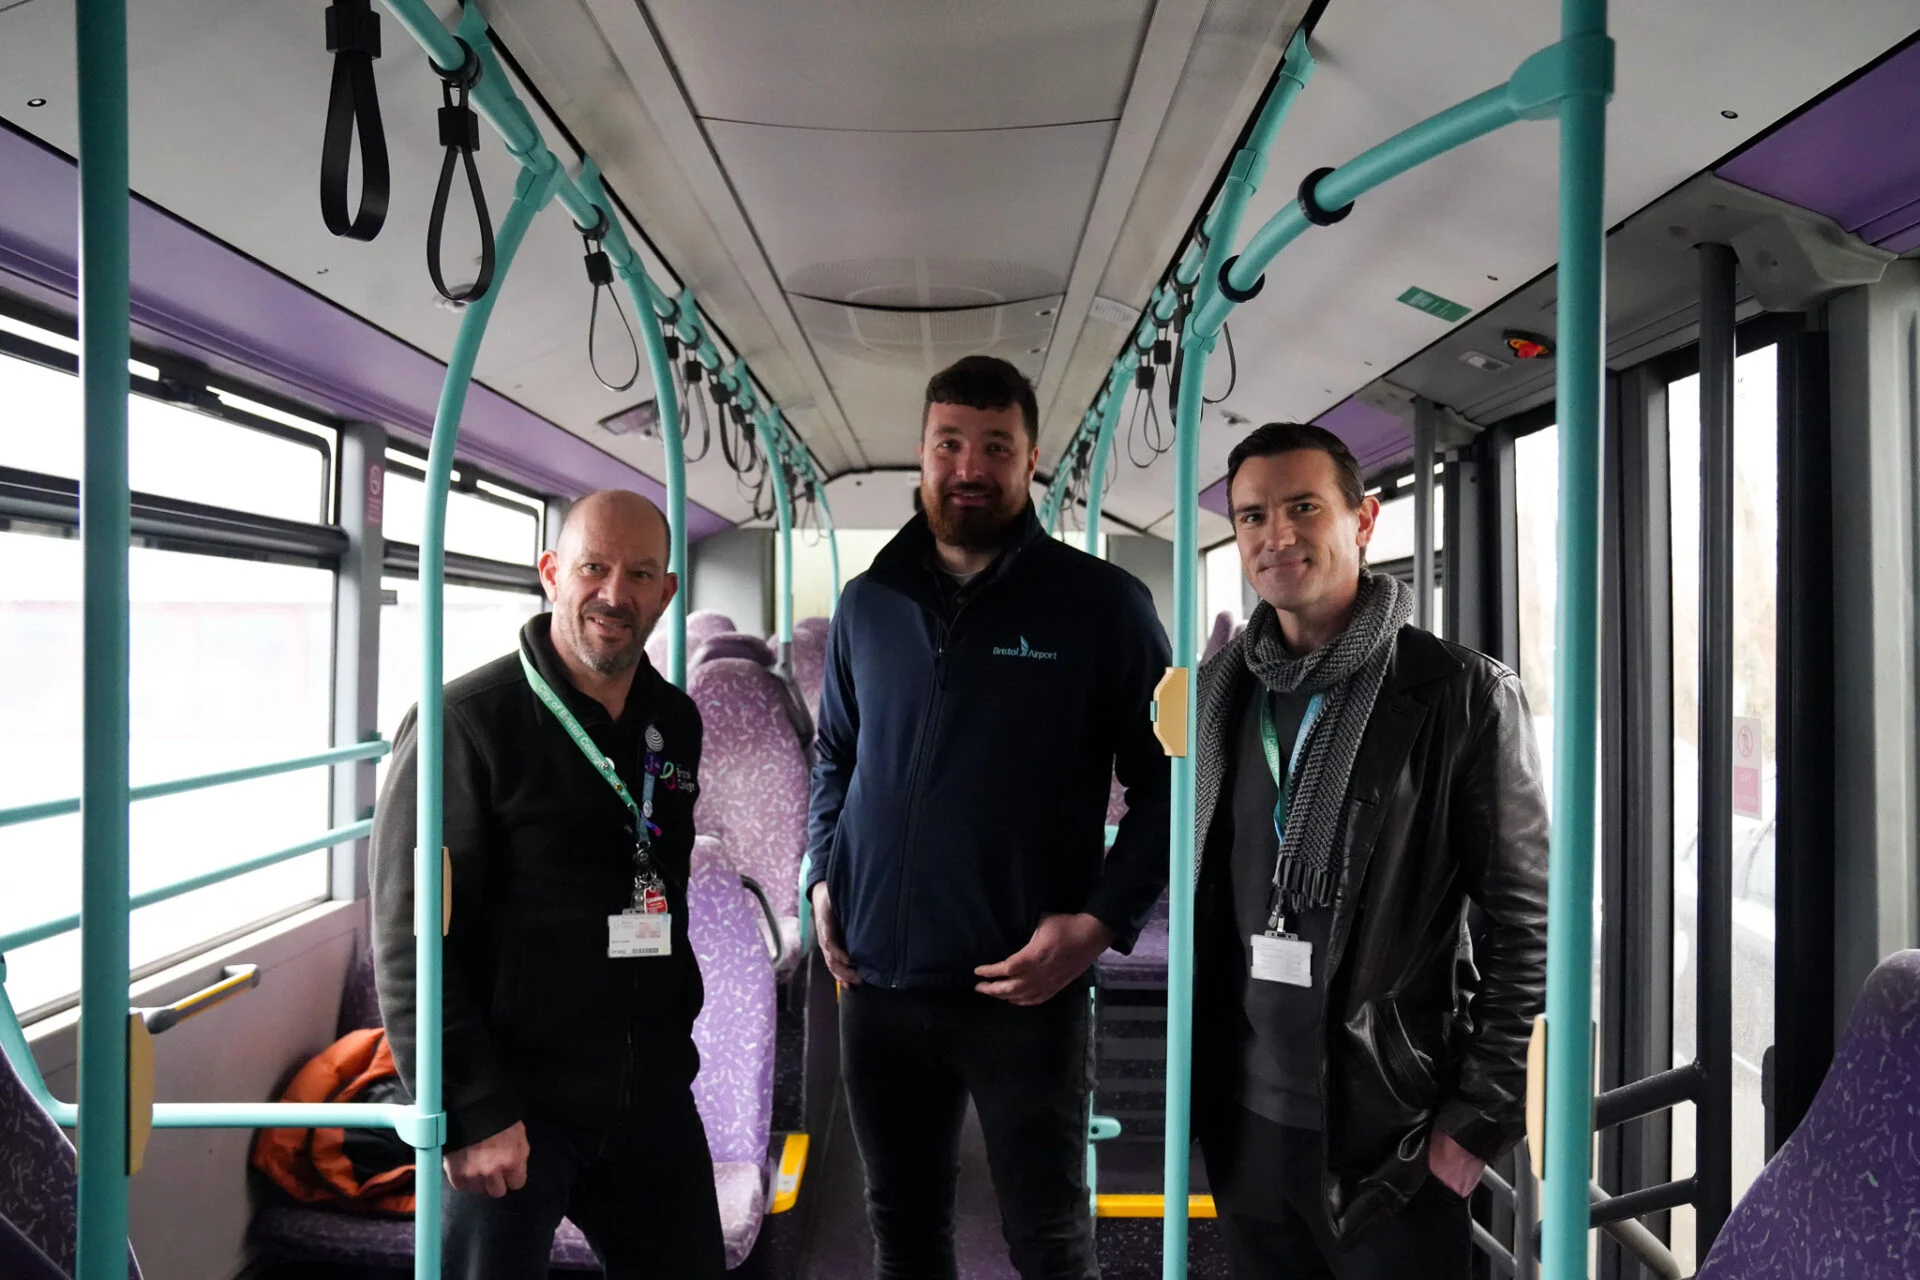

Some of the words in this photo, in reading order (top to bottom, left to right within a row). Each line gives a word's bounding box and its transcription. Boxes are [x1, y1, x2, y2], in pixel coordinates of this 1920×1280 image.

[993, 646, 1019, 656] Bristol
[1028, 650, 1057, 660] Airport
[538, 684, 553, 702] City
[551, 701, 560, 711] of
[559, 708, 583, 738] Bristol
